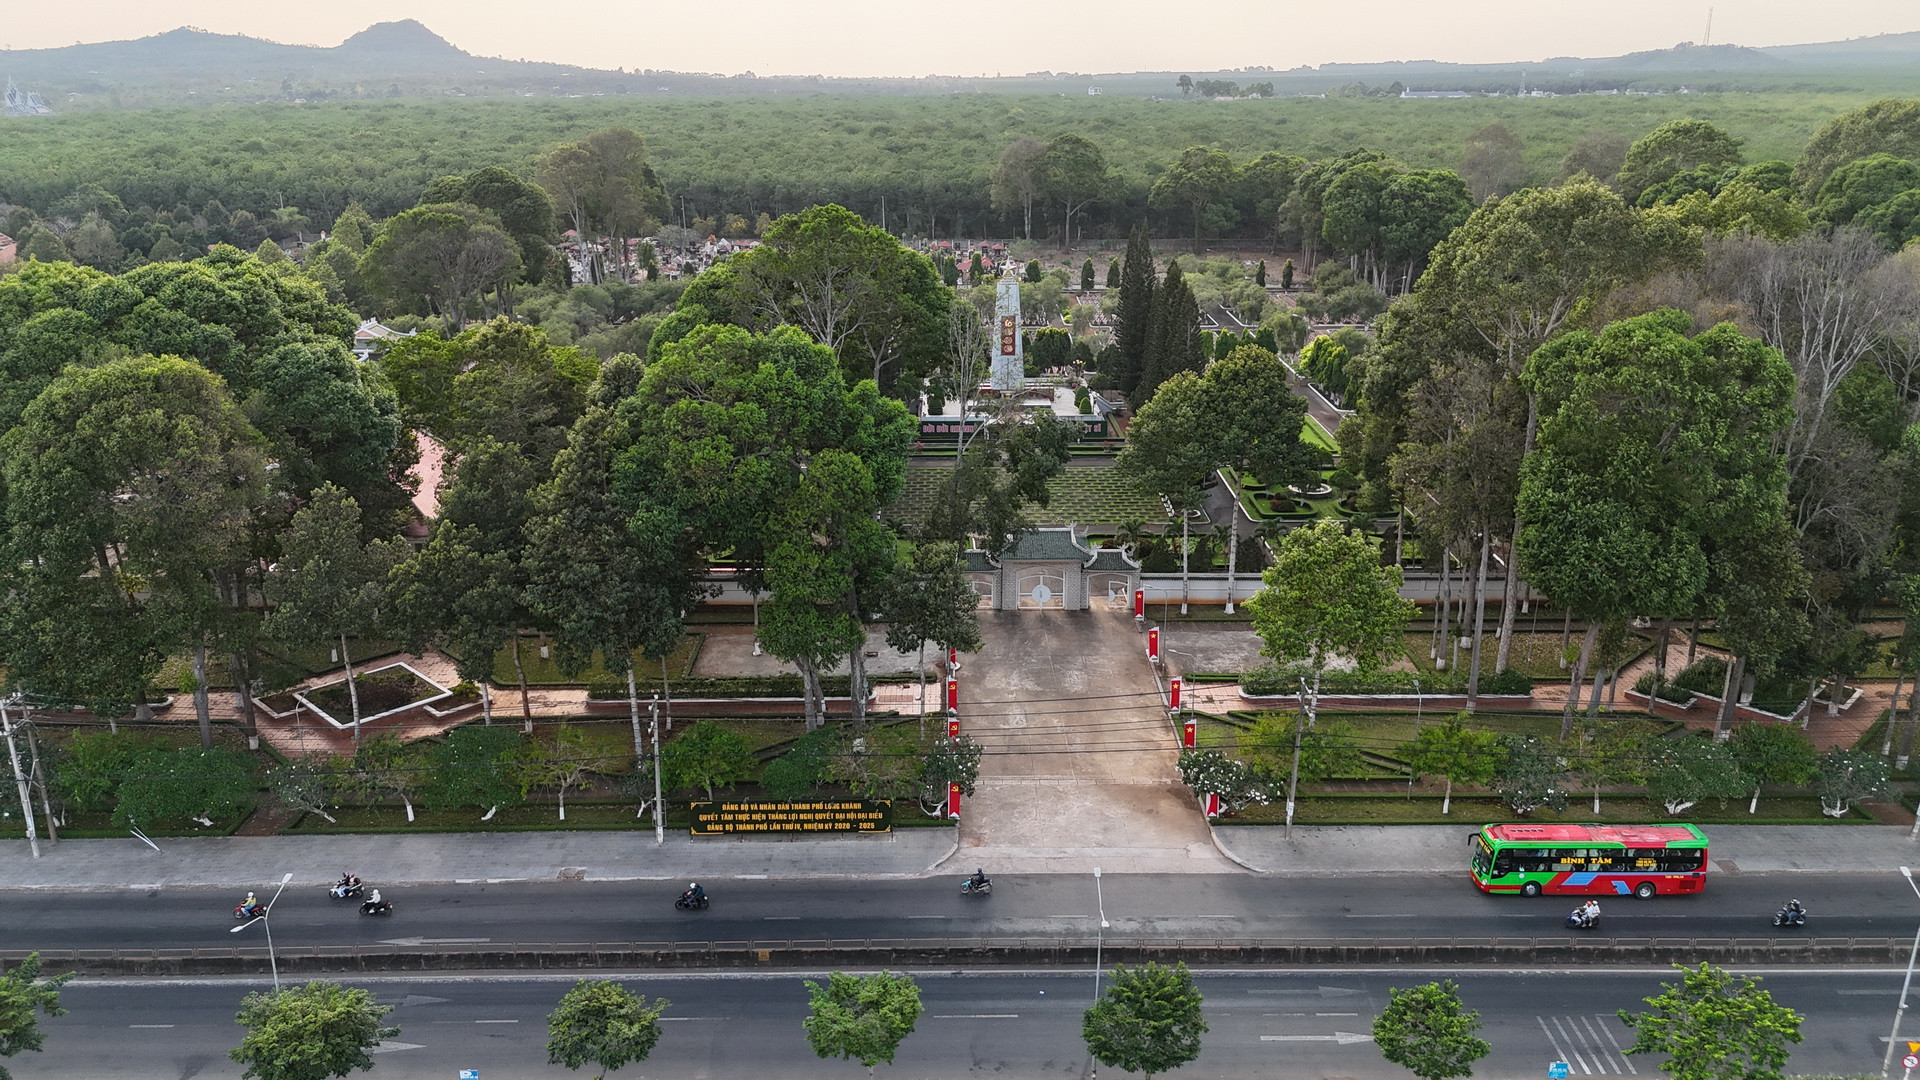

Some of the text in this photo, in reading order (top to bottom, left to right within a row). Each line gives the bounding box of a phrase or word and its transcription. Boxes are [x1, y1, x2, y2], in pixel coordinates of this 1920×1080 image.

[722, 802, 738, 810] ĐẢNG
[740, 804, 748, 812] BỘ
[777, 802, 789, 810] DÂN
[812, 801, 823, 810] PHỐ
[699, 812, 718, 821] QUYẾT
[735, 813, 750, 822] THỰC
[752, 812, 766, 821] HIỆN
[788, 813, 798, 821] LỢI
[800, 813, 814, 821] NGHỊ
[815, 811, 834, 820] QUYẾT
[836, 812, 845, 821] ĐẠI
[846, 812, 856, 820] HỘI
[869, 809, 882, 819] BIỂU
[707, 822, 723, 830] ĐẢNG
[726, 823, 733, 832] BỘ
[756, 822, 767, 830] PHỐ
[804, 822, 823, 831] NHIỆM
